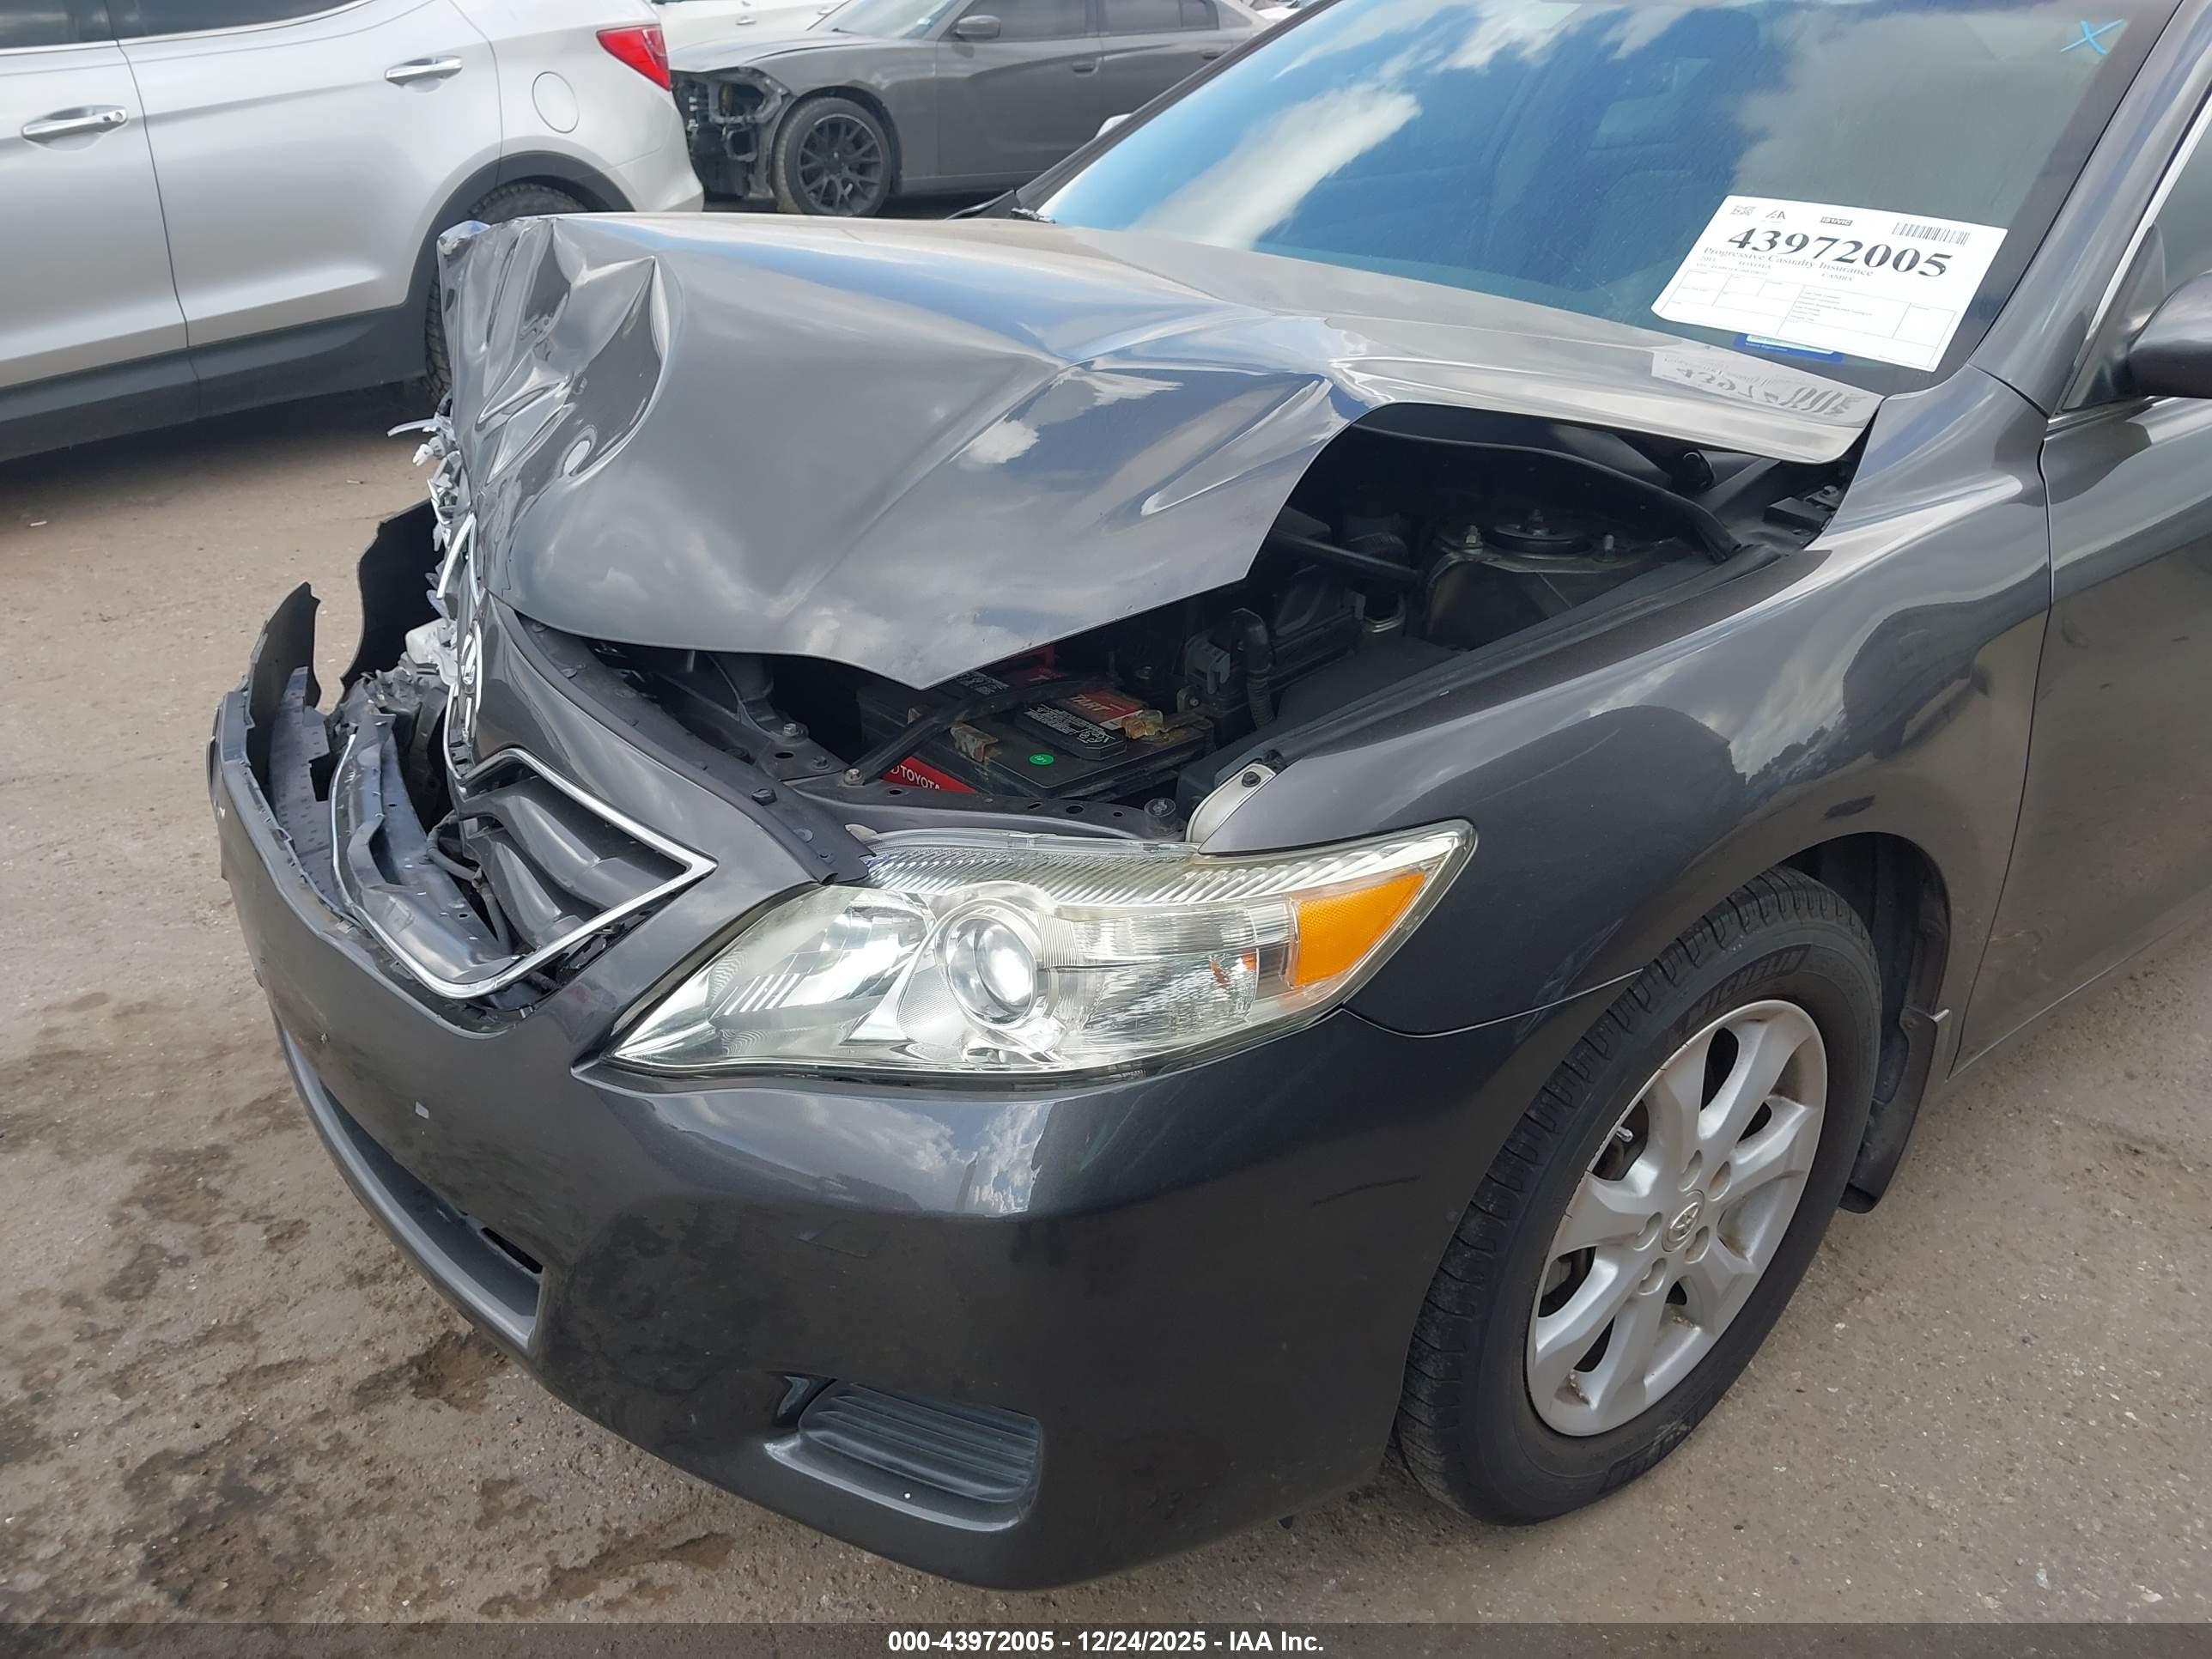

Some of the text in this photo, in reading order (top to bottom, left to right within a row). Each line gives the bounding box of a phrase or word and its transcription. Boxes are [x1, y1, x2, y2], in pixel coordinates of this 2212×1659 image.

[1704, 246, 1765, 261] Progressive
[1768, 254, 1815, 270] Casualty
[1819, 261, 1874, 276] Insurance
[1727, 227, 1954, 277] 43972005
[1070, 694, 1114, 712] TART
[900, 764, 940, 790] TOYOTA
